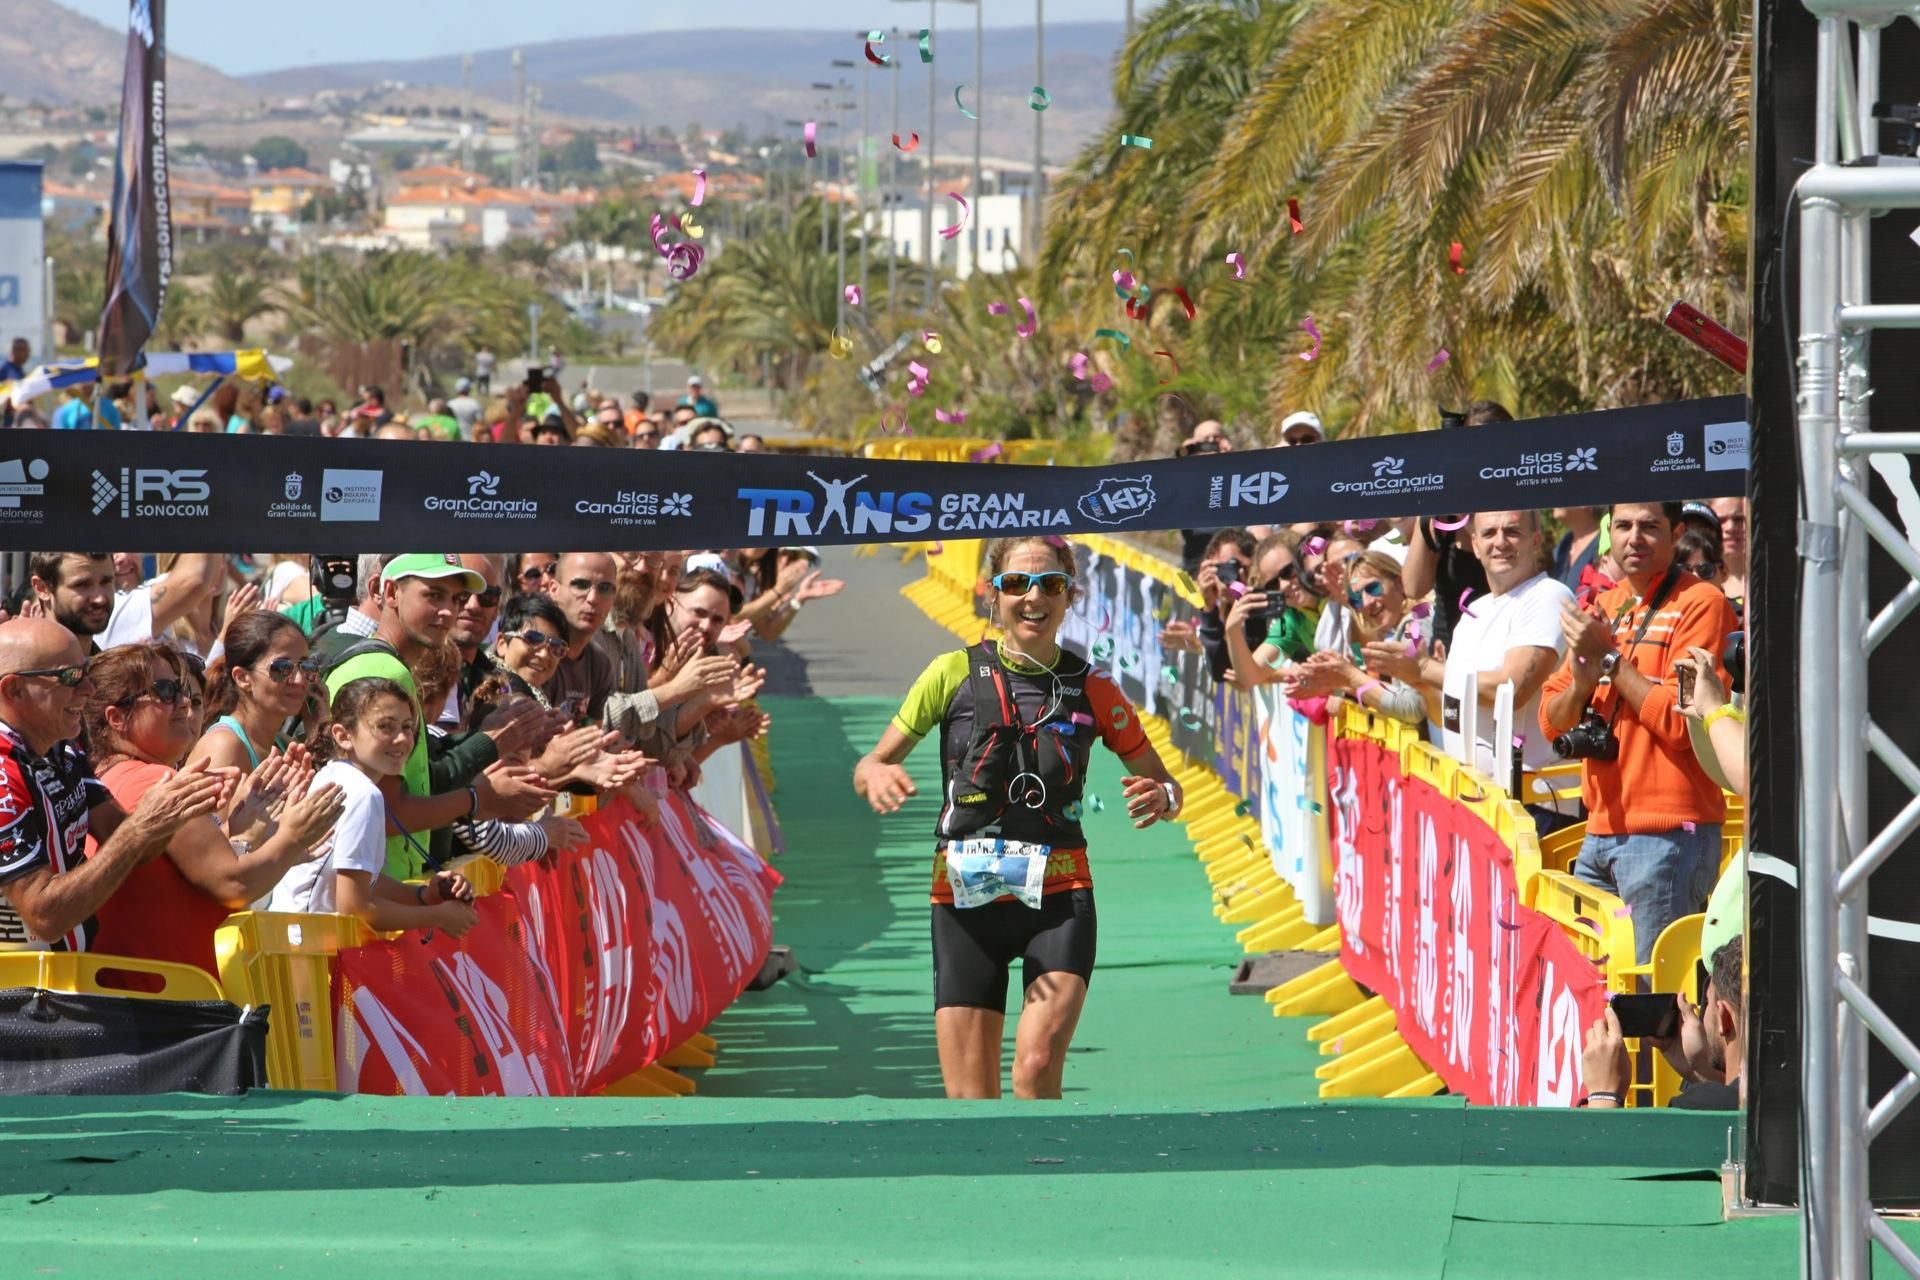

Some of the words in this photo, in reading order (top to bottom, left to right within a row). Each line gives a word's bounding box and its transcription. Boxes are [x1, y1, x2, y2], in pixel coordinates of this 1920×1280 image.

[1520, 451, 1563, 464] Islas
[1654, 458, 1684, 466] Cabildo
[1685, 457, 1695, 465] de
[1479, 462, 1563, 480] Canarias
[1650, 465, 1670, 473] Gran
[1671, 463, 1701, 471] Canaria
[1331, 473, 1444, 493] GranCanaria
[616, 491, 659, 504] Islas
[1361, 488, 1400, 497] Patronato
[1401, 486, 1411, 494] de
[1413, 484, 1444, 493] Turismo
[424, 496, 538, 513] GranCanaria
[575, 500, 658, 516] Canarias
[737, 471, 933, 536] TRANS
[940, 492, 1025, 513] GRAN
[136, 504, 209, 516] SONOCOM
[454, 511, 493, 519] Patronato
[494, 511, 505, 519] de
[506, 512, 537, 520] Turismo
[938, 509, 1072, 531] CANARIA
